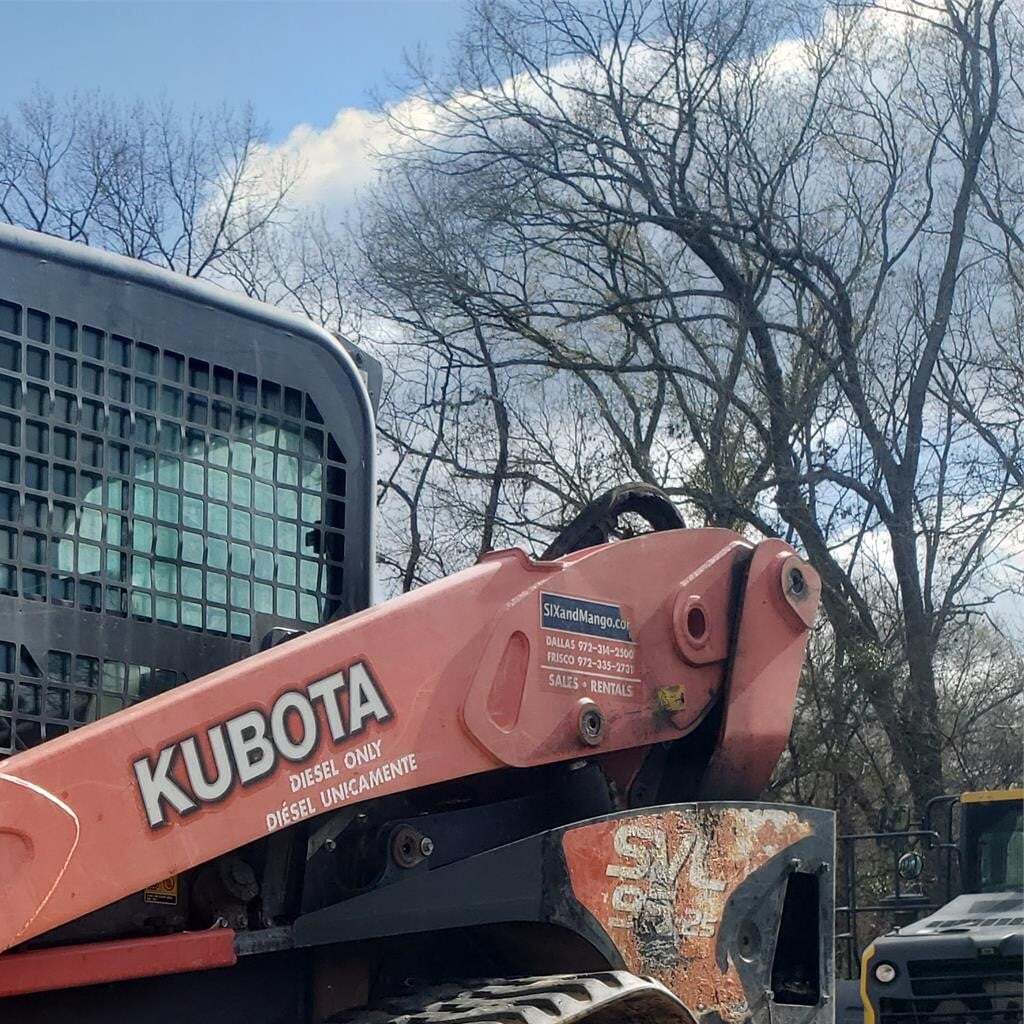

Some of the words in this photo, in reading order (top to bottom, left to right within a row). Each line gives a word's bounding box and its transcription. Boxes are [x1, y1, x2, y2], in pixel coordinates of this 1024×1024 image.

[546, 635, 576, 651] DALLAS
[578, 640, 634, 660] 972-314-2500
[547, 651, 575, 665] FRISCO
[549, 673, 579, 690] SALES
[590, 679, 633, 697] RENTALS
[133, 660, 390, 828] KUBOTA
[289, 757, 340, 793] DIESEL
[343, 739, 383, 770] ONLY
[266, 802, 317, 833] DIÉSEL
